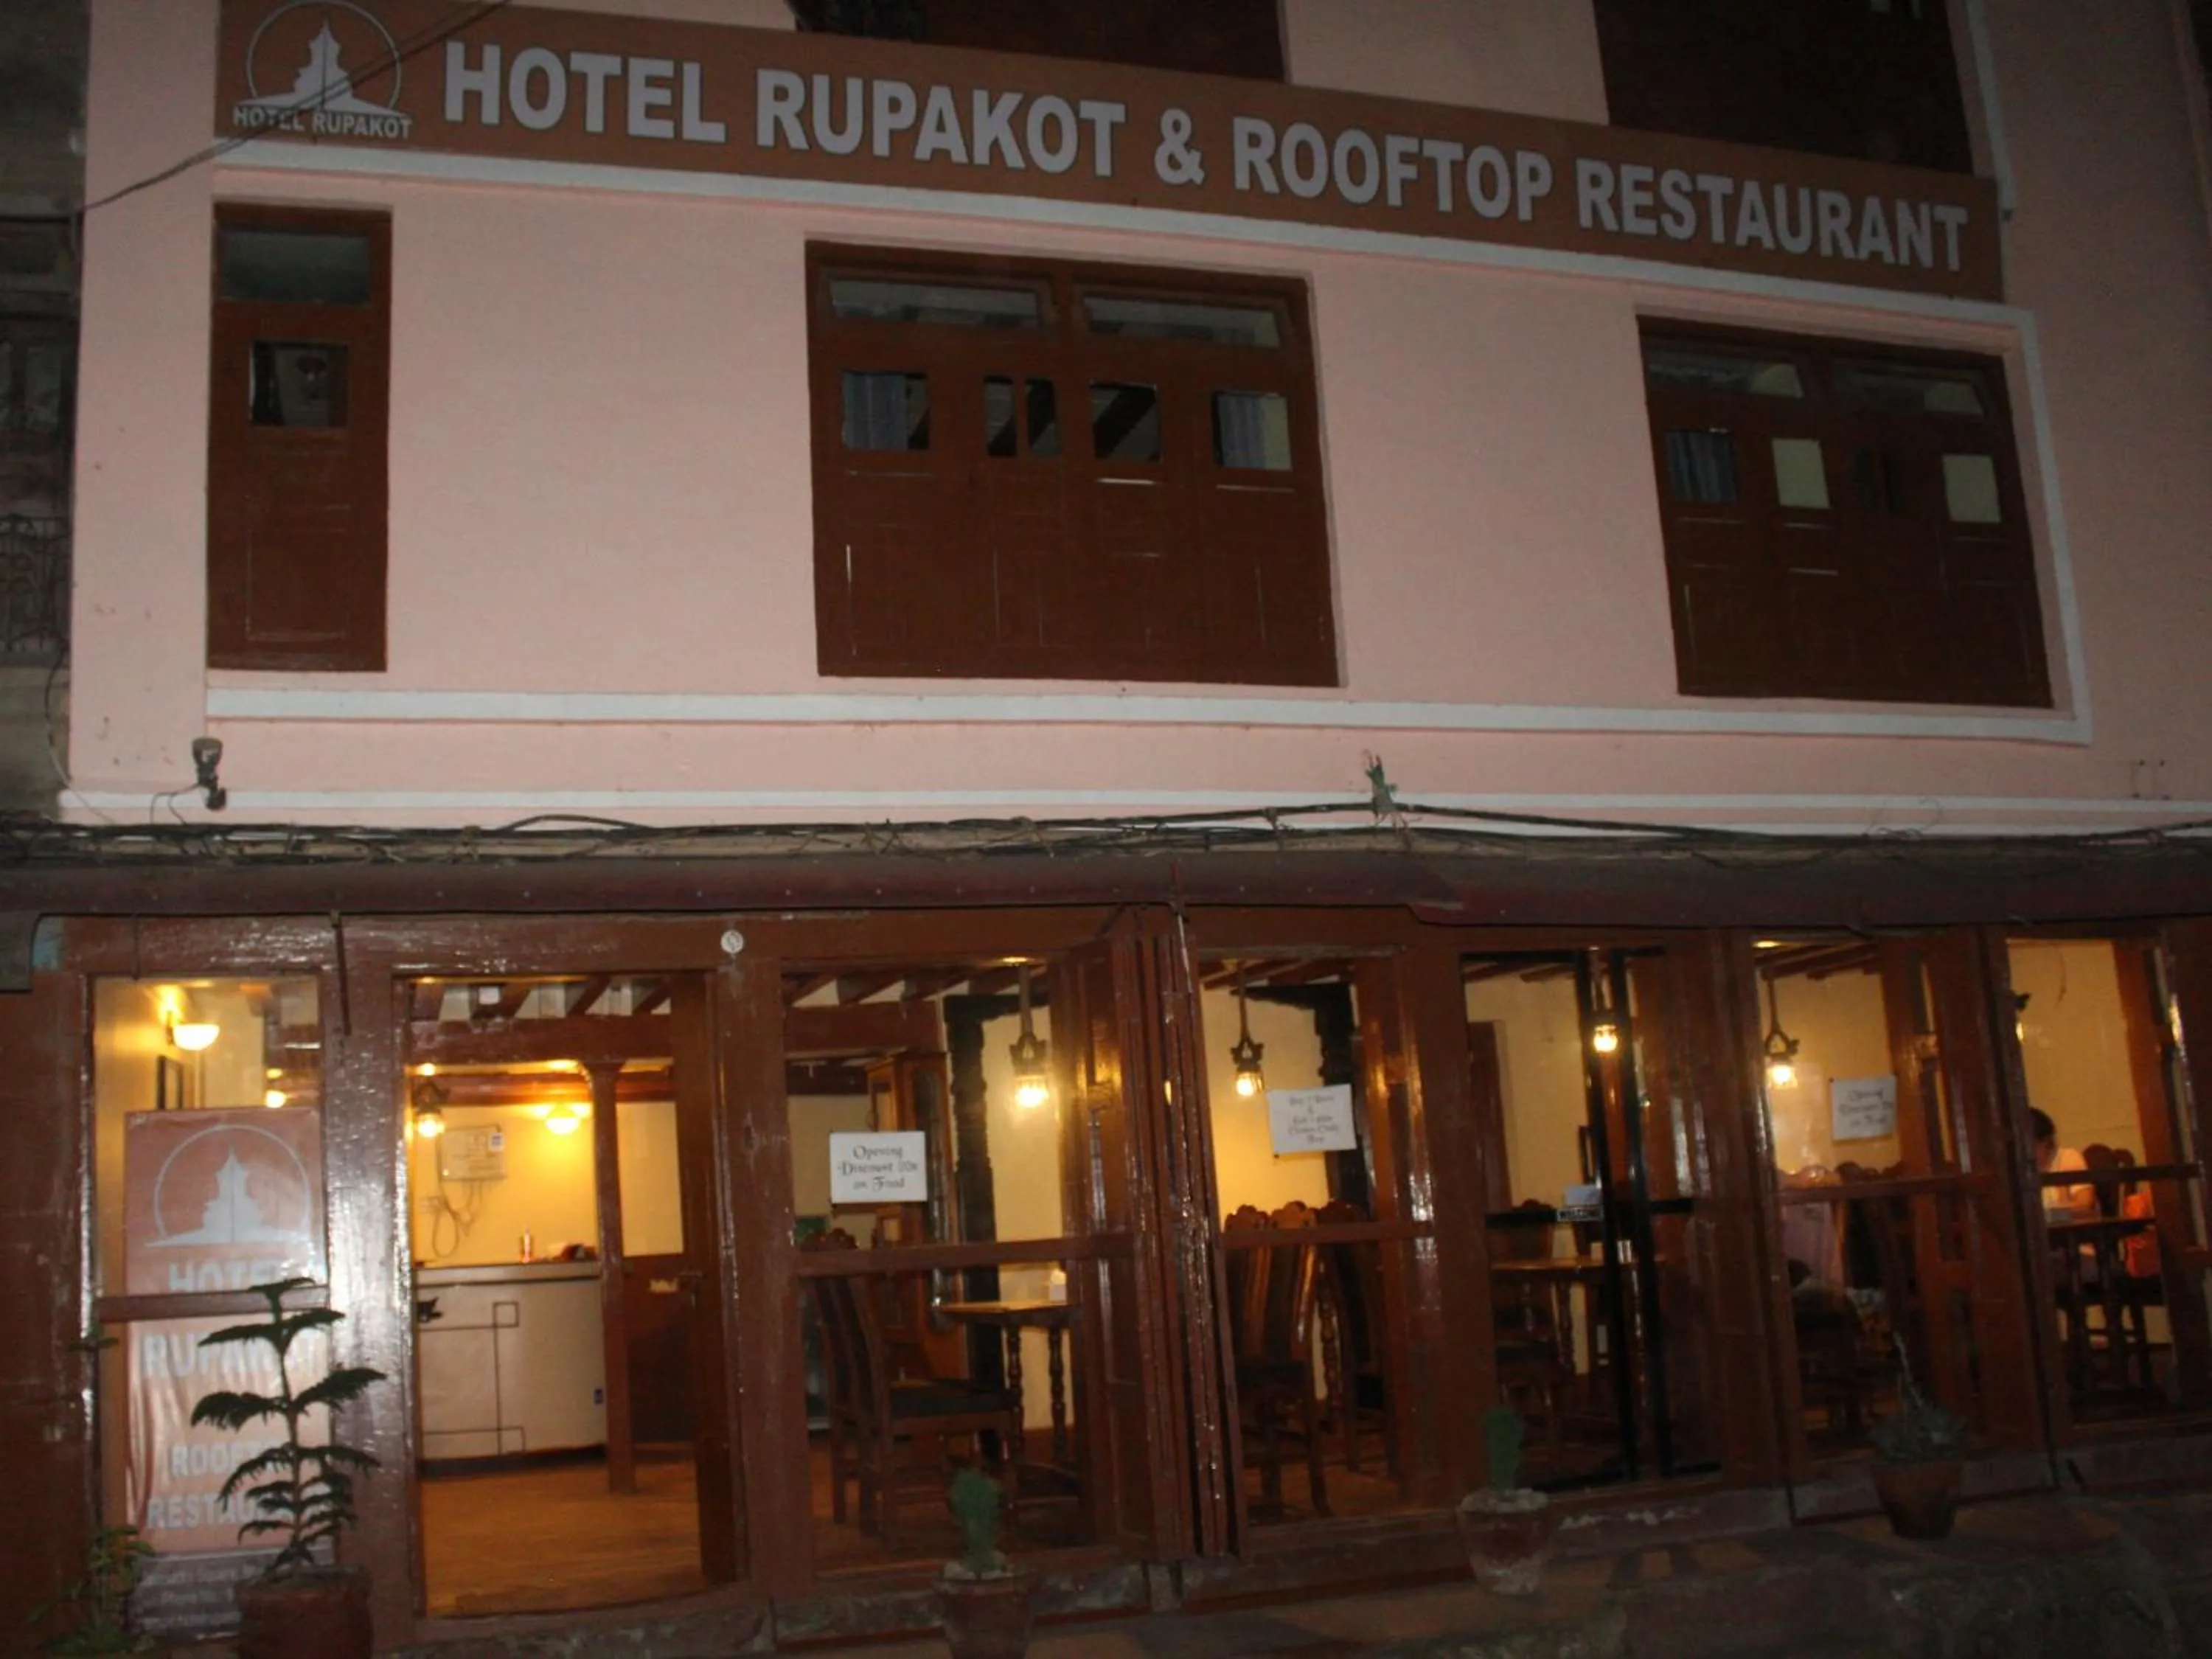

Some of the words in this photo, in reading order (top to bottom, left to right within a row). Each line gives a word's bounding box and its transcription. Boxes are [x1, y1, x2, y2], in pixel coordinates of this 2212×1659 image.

[232, 105, 306, 133] HOTEL
[312, 111, 413, 140] RUPAKOT
[443, 40, 727, 144] HOTEL
[755, 67, 1126, 177] RUPAKOT
[1154, 108, 1206, 187] &
[1232, 115, 1553, 222] ROOFTOP
[1575, 157, 1969, 273] RESTAURANT
